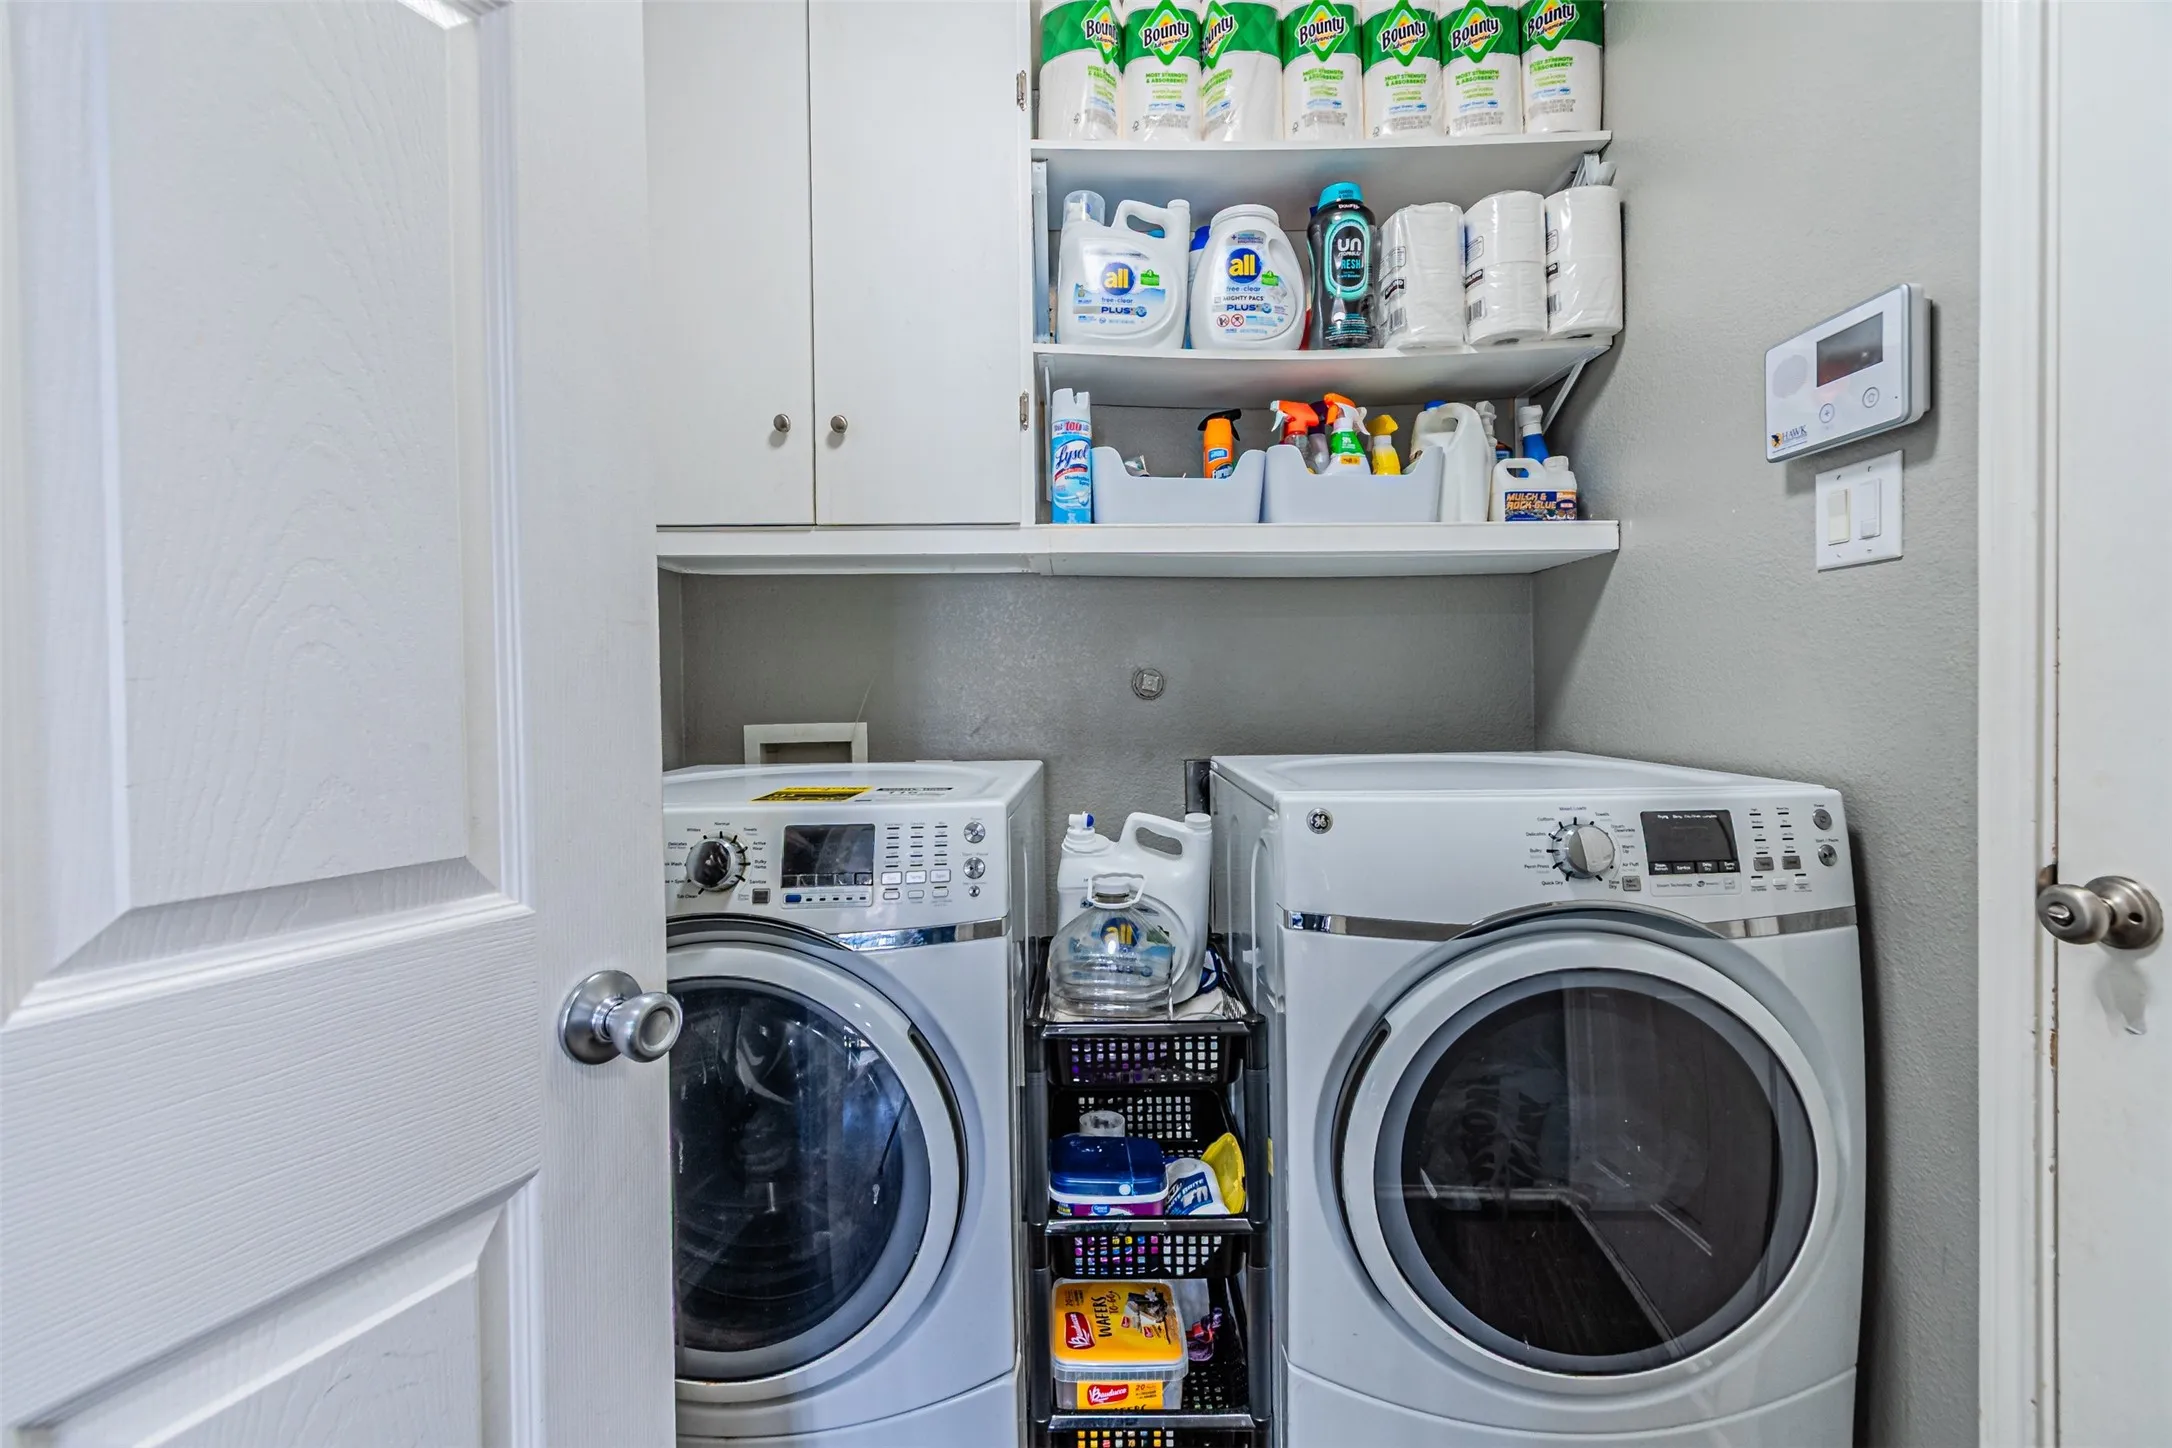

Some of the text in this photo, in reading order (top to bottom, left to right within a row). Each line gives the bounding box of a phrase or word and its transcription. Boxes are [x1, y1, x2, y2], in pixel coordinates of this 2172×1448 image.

[1085, 19, 1117, 38] Bount
[1299, 17, 1345, 46] Bounty
[1527, 3, 1575, 40] Bounty
[1143, 20, 1190, 47] Bounty
[1153, 36, 1182, 48] Advanced
[1309, 33, 1337, 44] Advanced
[1381, 20, 1426, 51] Bounty
[1392, 37, 1419, 50] Advanced
[1452, 18, 1499, 49] Bounty
[1463, 34, 1491, 48] Advanced
[1462, 75, 1499, 84] ABSORBENCY
[1473, 69, 1499, 77] STRENGTH
[1229, 254, 1256, 277] all
[1338, 259, 1361, 269] RESH
[1104, 268, 1129, 289] all
[1780, 425, 1807, 440] HAWK
[1056, 443, 1088, 469] Lysol
[1507, 492, 1538, 501] MULCH
[1104, 924, 1133, 946] all
[1182, 1178, 1204, 1195] BRITE
[1106, 1292, 1119, 1314] TO-GO
[1091, 1296, 1113, 1337] WAFERS
[1068, 1313, 1091, 1348] Bauducco
[1089, 1386, 1127, 1403] Bauducco
